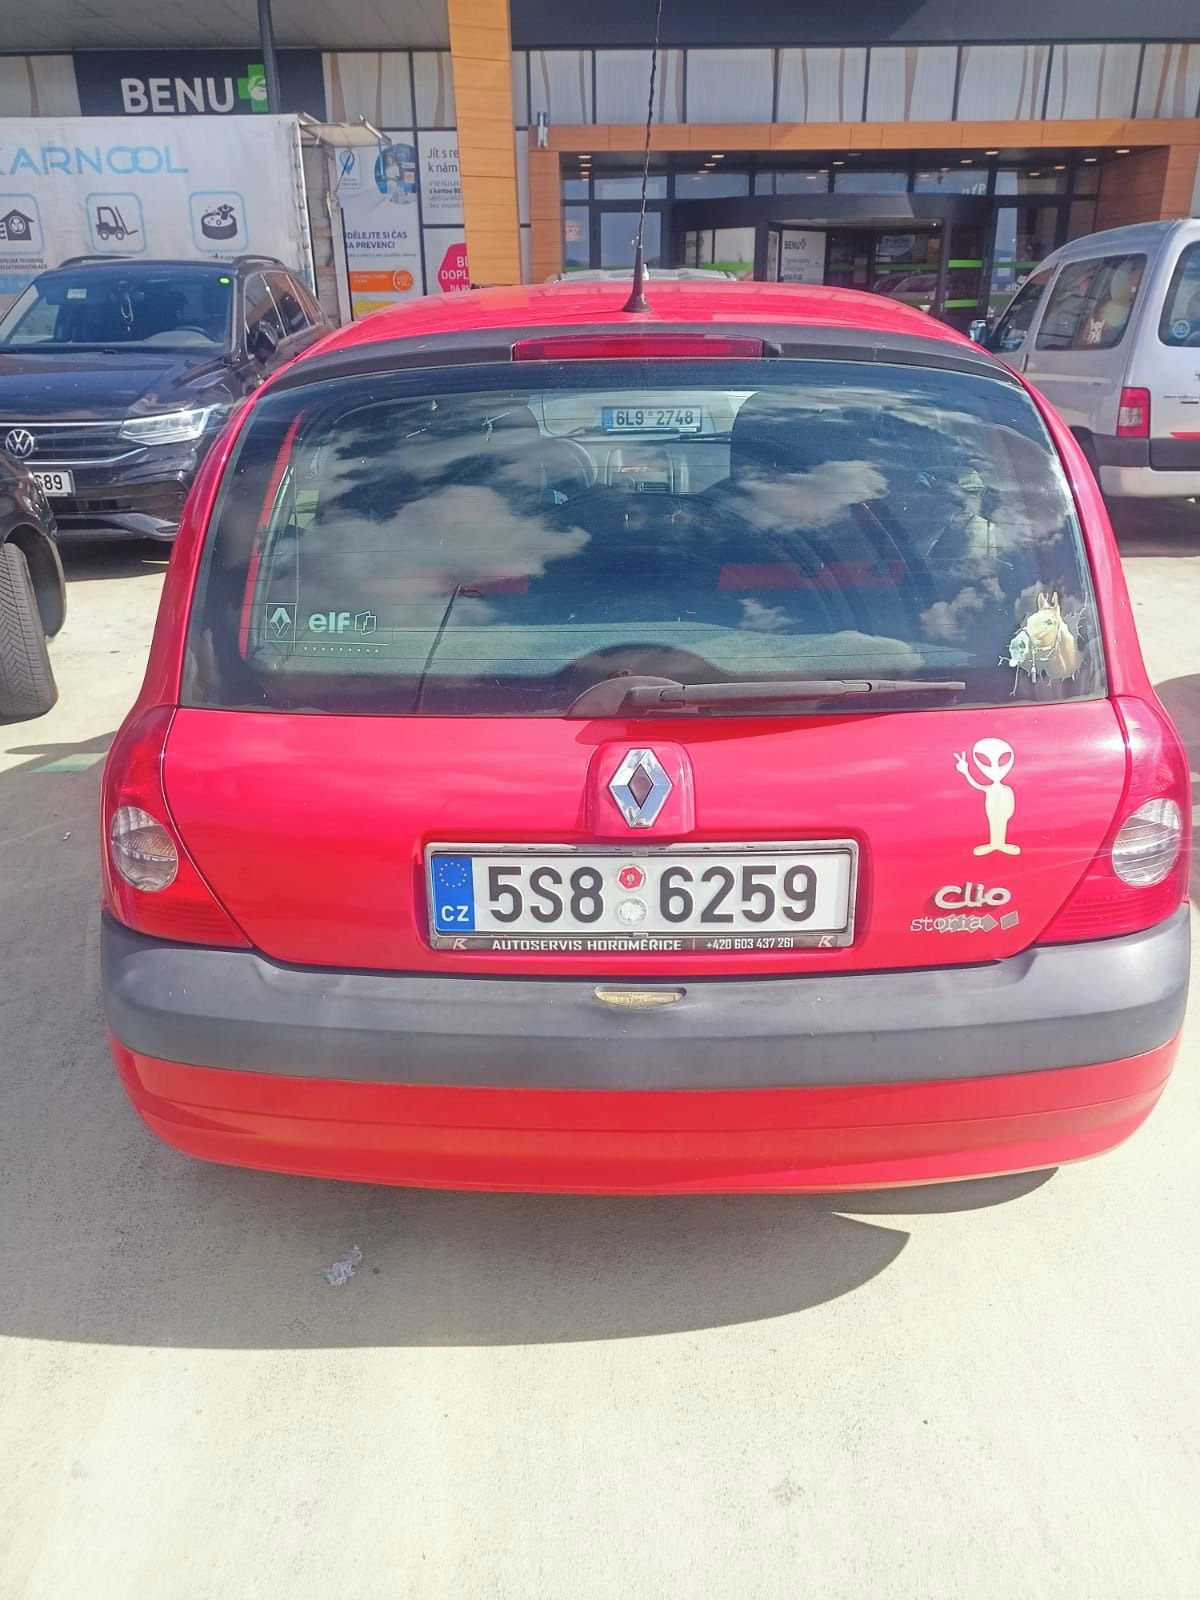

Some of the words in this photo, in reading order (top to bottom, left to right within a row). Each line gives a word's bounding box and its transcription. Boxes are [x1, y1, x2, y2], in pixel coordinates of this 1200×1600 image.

[120, 77, 235, 113] BENU
[0, 145, 189, 176] ARNOOL
[441, 150, 448, 158] s
[428, 162, 434, 173] k
[436, 161, 458, 173] nám
[382, 231, 390, 239] SI
[391, 229, 408, 239] ČAS
[355, 241, 395, 249] PREVENCI
[616, 410, 644, 426] 6L9
[656, 410, 693, 426] 2748
[308, 611, 350, 634] elf
[487, 865, 604, 924] 5S8
[658, 865, 818, 923] 6259
[934, 881, 1012, 910] Clio
[440, 904, 471, 923] CZ
[909, 914, 984, 933] storia
[492, 939, 582, 951] AUTOSERVIS
[587, 938, 682, 951] HOROMĚŘICE
[705, 938, 731, 950] +420
[734, 938, 754, 949] 603
[756, 938, 774, 949] 437
[777, 937, 794, 948] 261
